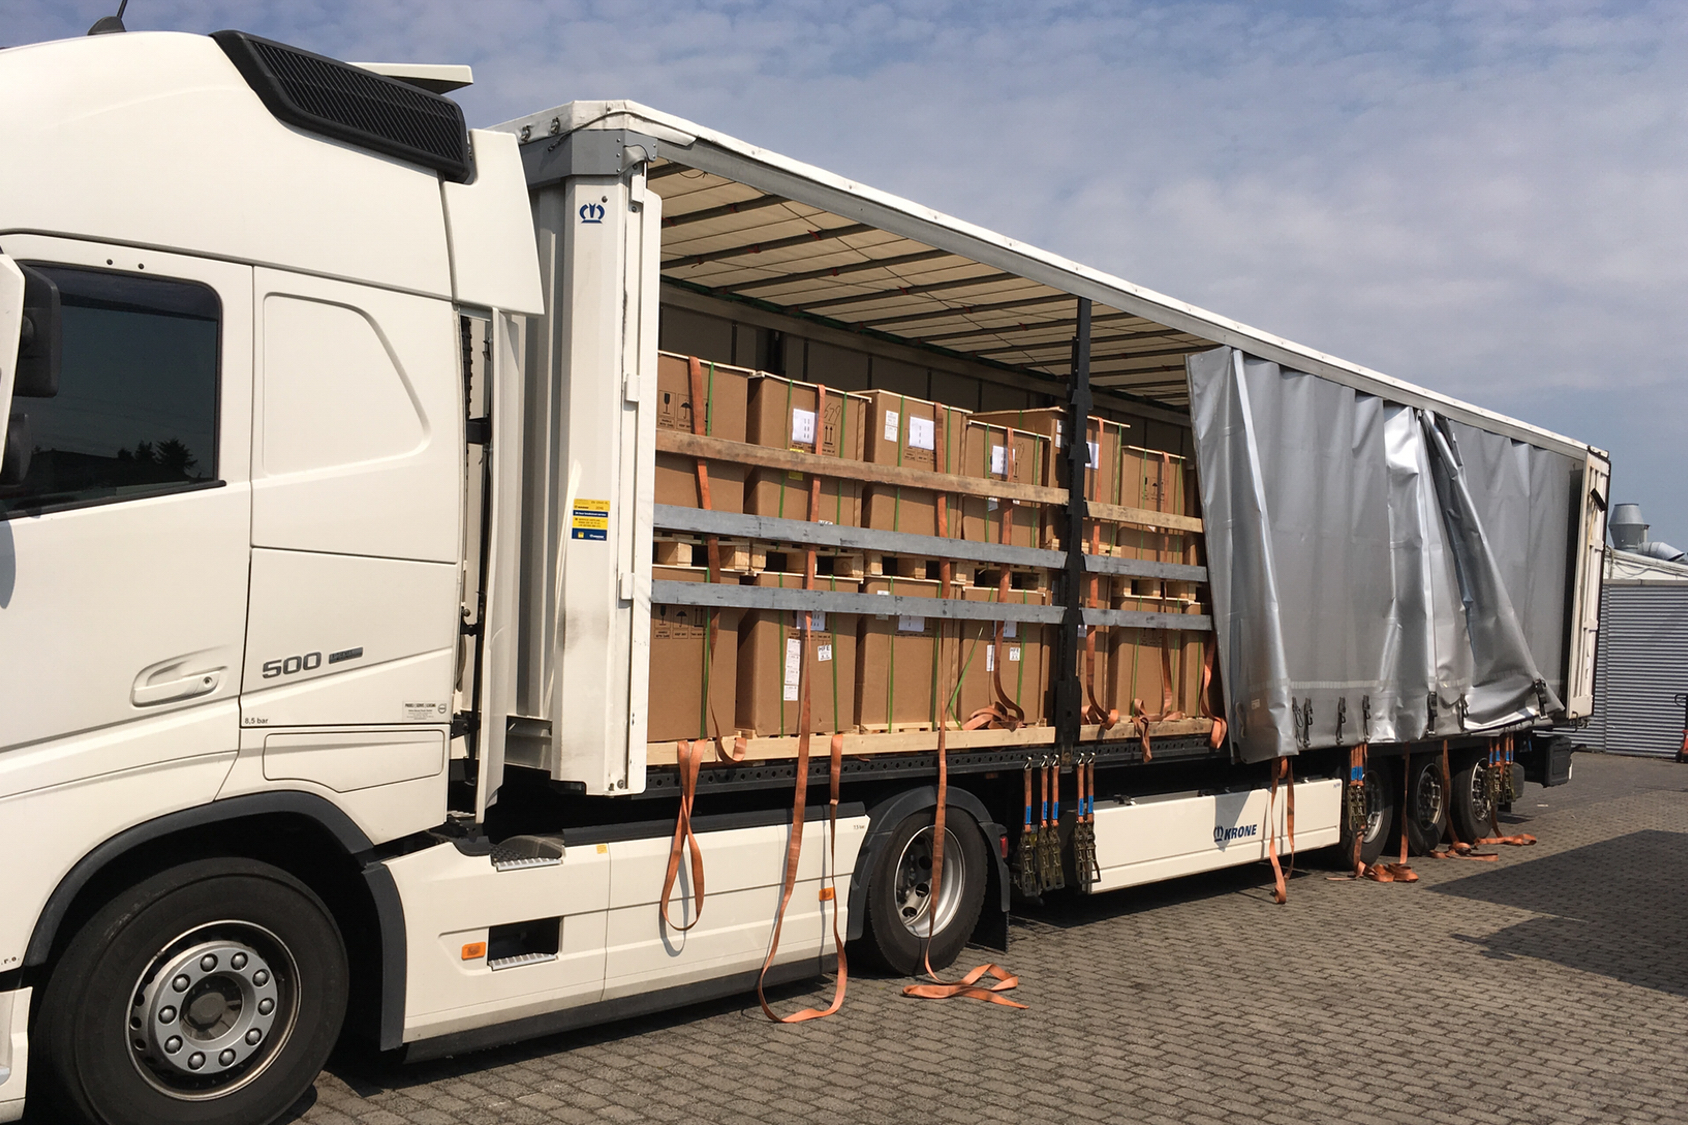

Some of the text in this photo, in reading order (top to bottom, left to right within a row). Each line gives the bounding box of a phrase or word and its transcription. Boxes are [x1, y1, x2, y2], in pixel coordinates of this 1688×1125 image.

[262, 652, 322, 679] 500
[244, 717, 256, 725] 8,5
[1223, 823, 1258, 841] KRONE
